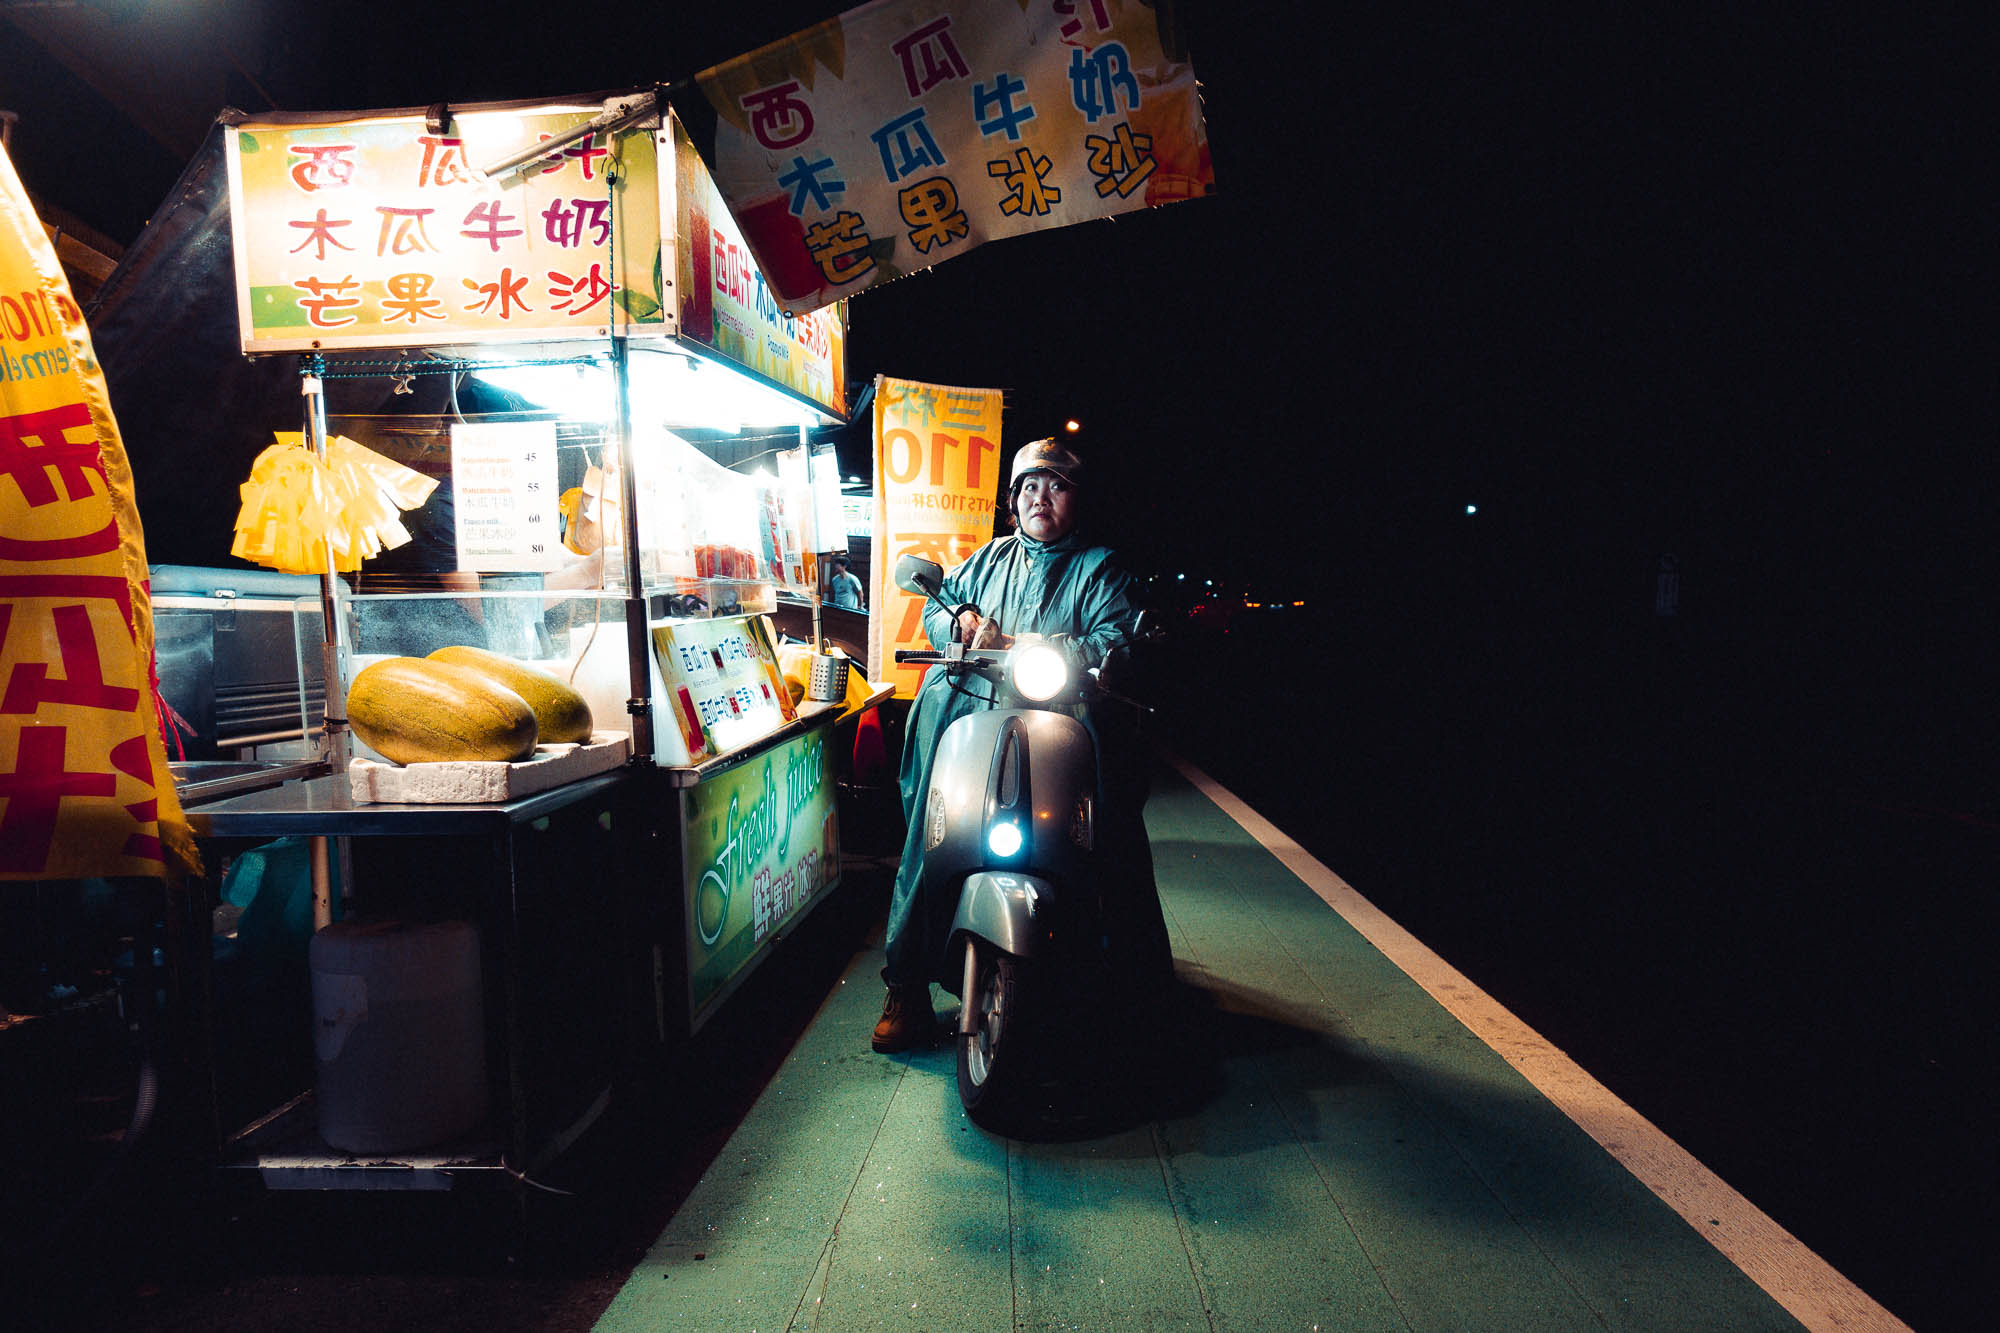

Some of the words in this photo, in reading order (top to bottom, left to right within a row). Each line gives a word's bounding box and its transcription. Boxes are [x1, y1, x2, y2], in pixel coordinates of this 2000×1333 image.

[778, 43, 1140, 216] 木瓜牛奶
[289, 198, 610, 260] 木瓜牛奶
[803, 121, 1158, 285] 芒果冰沙
[294, 264, 619, 327] 芒果冰沙
[713, 229, 752, 311] 西瓜汁
[524, 452, 536, 462] 45
[527, 482, 540, 492] 55
[528, 513, 540, 524] 60
[531, 543, 544, 554] 80
[698, 797, 776, 945] fresh
[779, 739, 823, 855] juice
